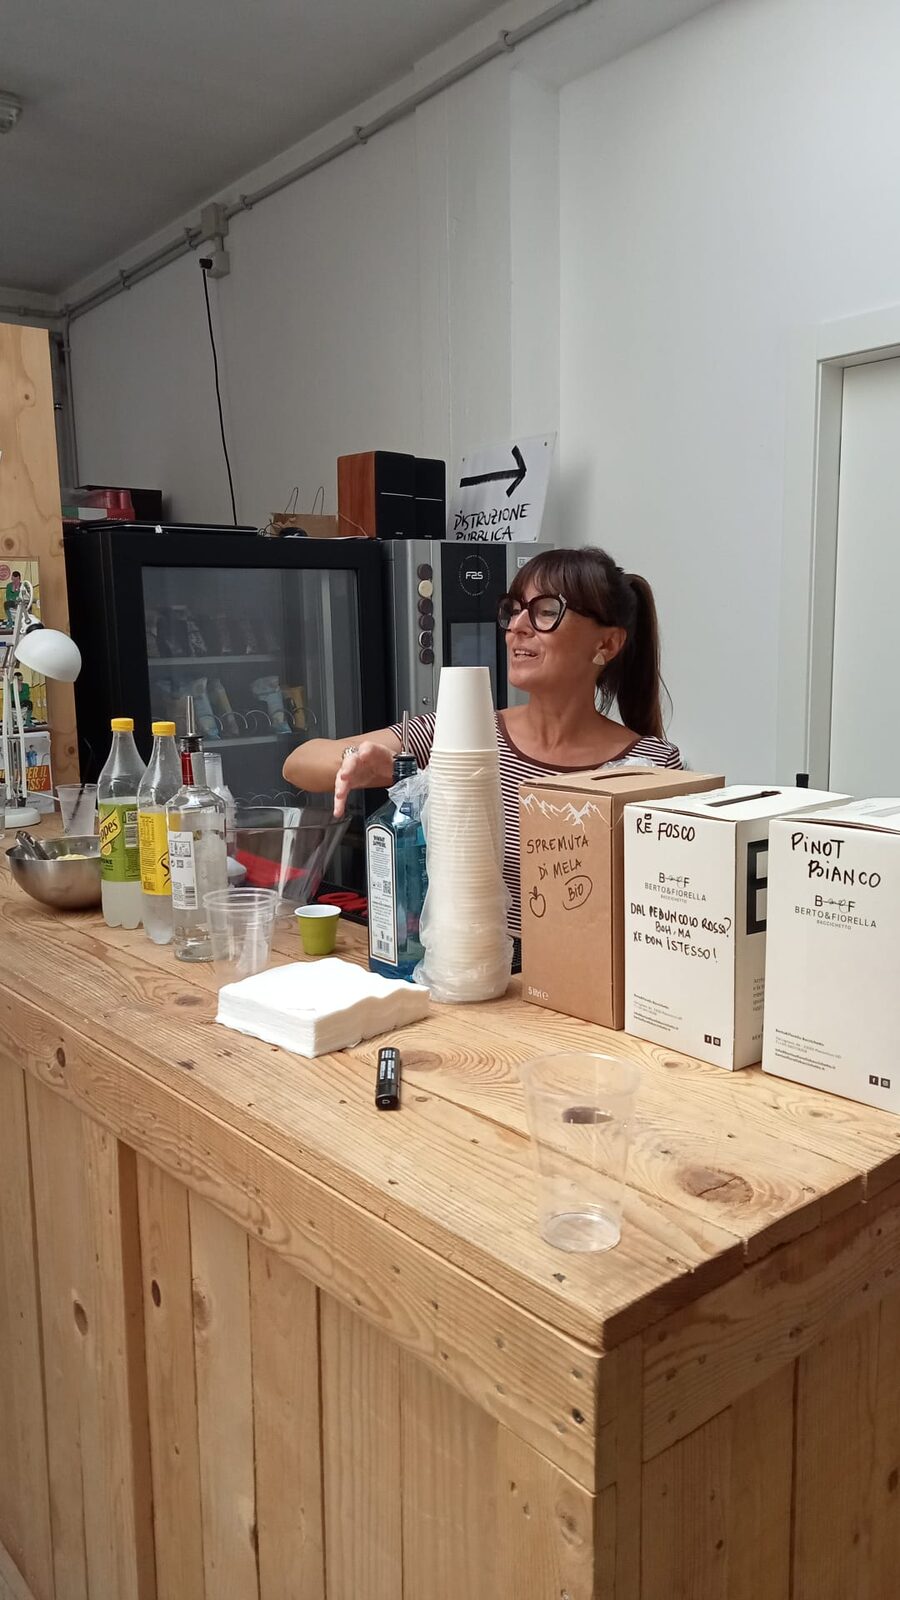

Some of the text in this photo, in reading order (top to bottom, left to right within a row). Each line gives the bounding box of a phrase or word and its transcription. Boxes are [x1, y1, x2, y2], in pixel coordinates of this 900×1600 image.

[657, 822, 695, 842] FOSCO
[526, 834, 589, 854] SPREMUTA
[553, 859, 582, 878] MELA
[645, 882, 708, 902] BERTO&FIORELLA
[631, 902, 646, 917] DAL
[795, 906, 877, 928] BERTO&FIORELLA
[678, 928, 691, 939] MA
